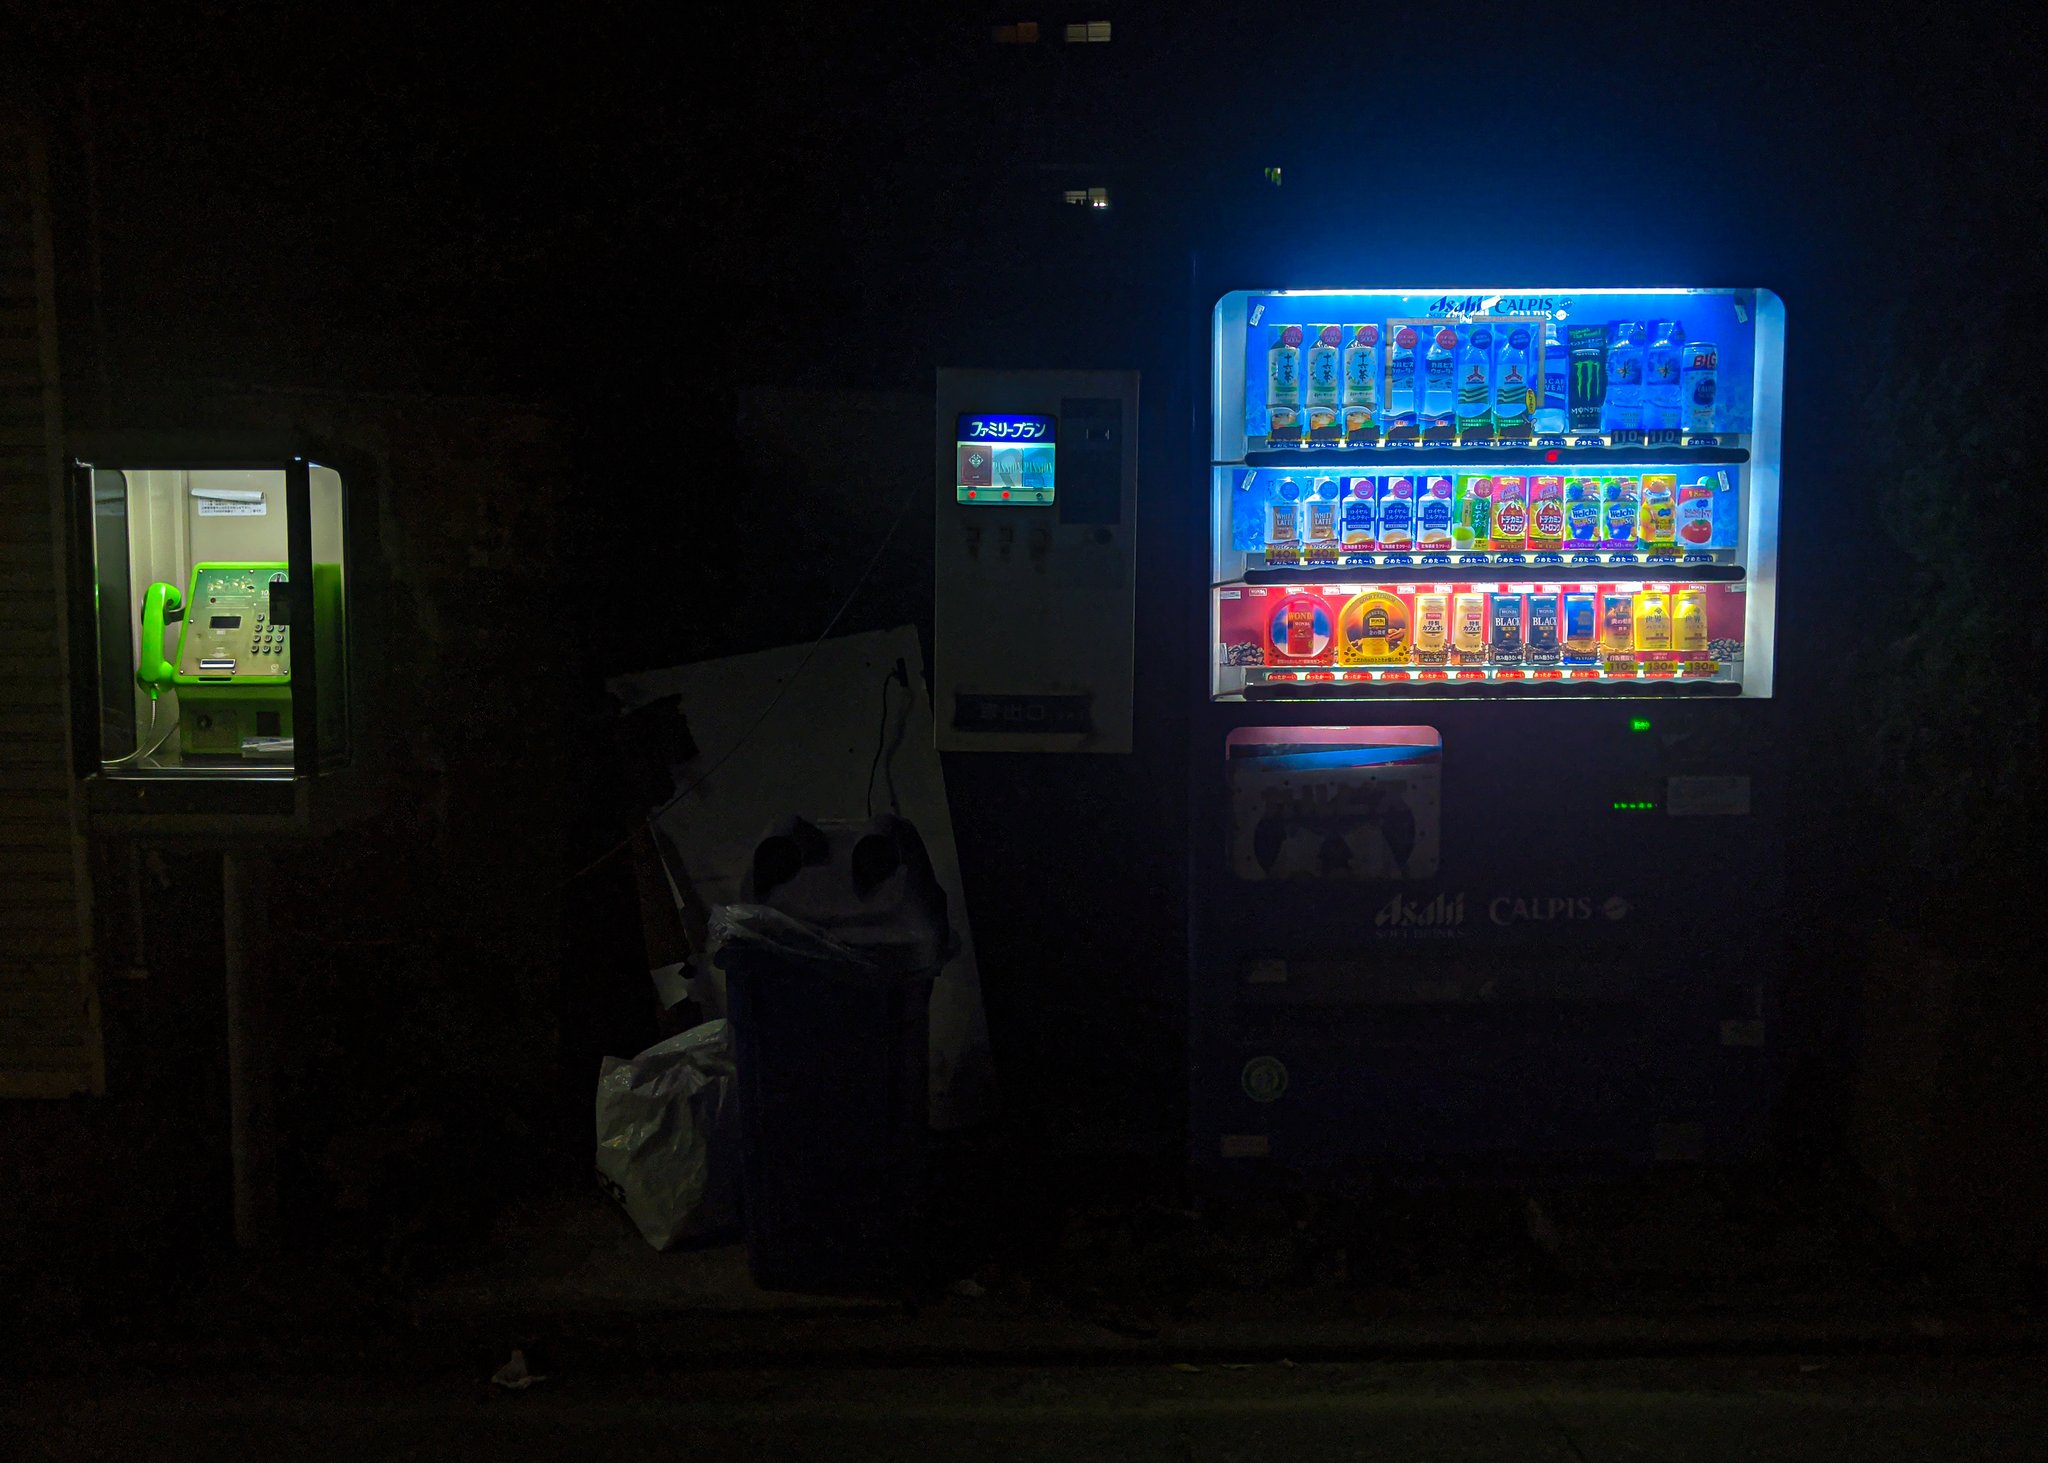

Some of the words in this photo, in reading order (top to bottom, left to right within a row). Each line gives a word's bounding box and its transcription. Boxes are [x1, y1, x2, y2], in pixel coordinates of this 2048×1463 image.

[1429, 295, 1484, 313] Asahi
[1495, 297, 1553, 314] CALPIS
[1283, 352, 1293, 382] 十六茶
[1322, 352, 1332, 382] 十六茶
[1358, 351, 1368, 382] 十六茶
[1571, 406, 1600, 414] MONSTE
[969, 421, 1046, 438] ファミリープラン
[1374, 891, 1465, 928] Asahi
[1488, 896, 1593, 927] CALPIS
